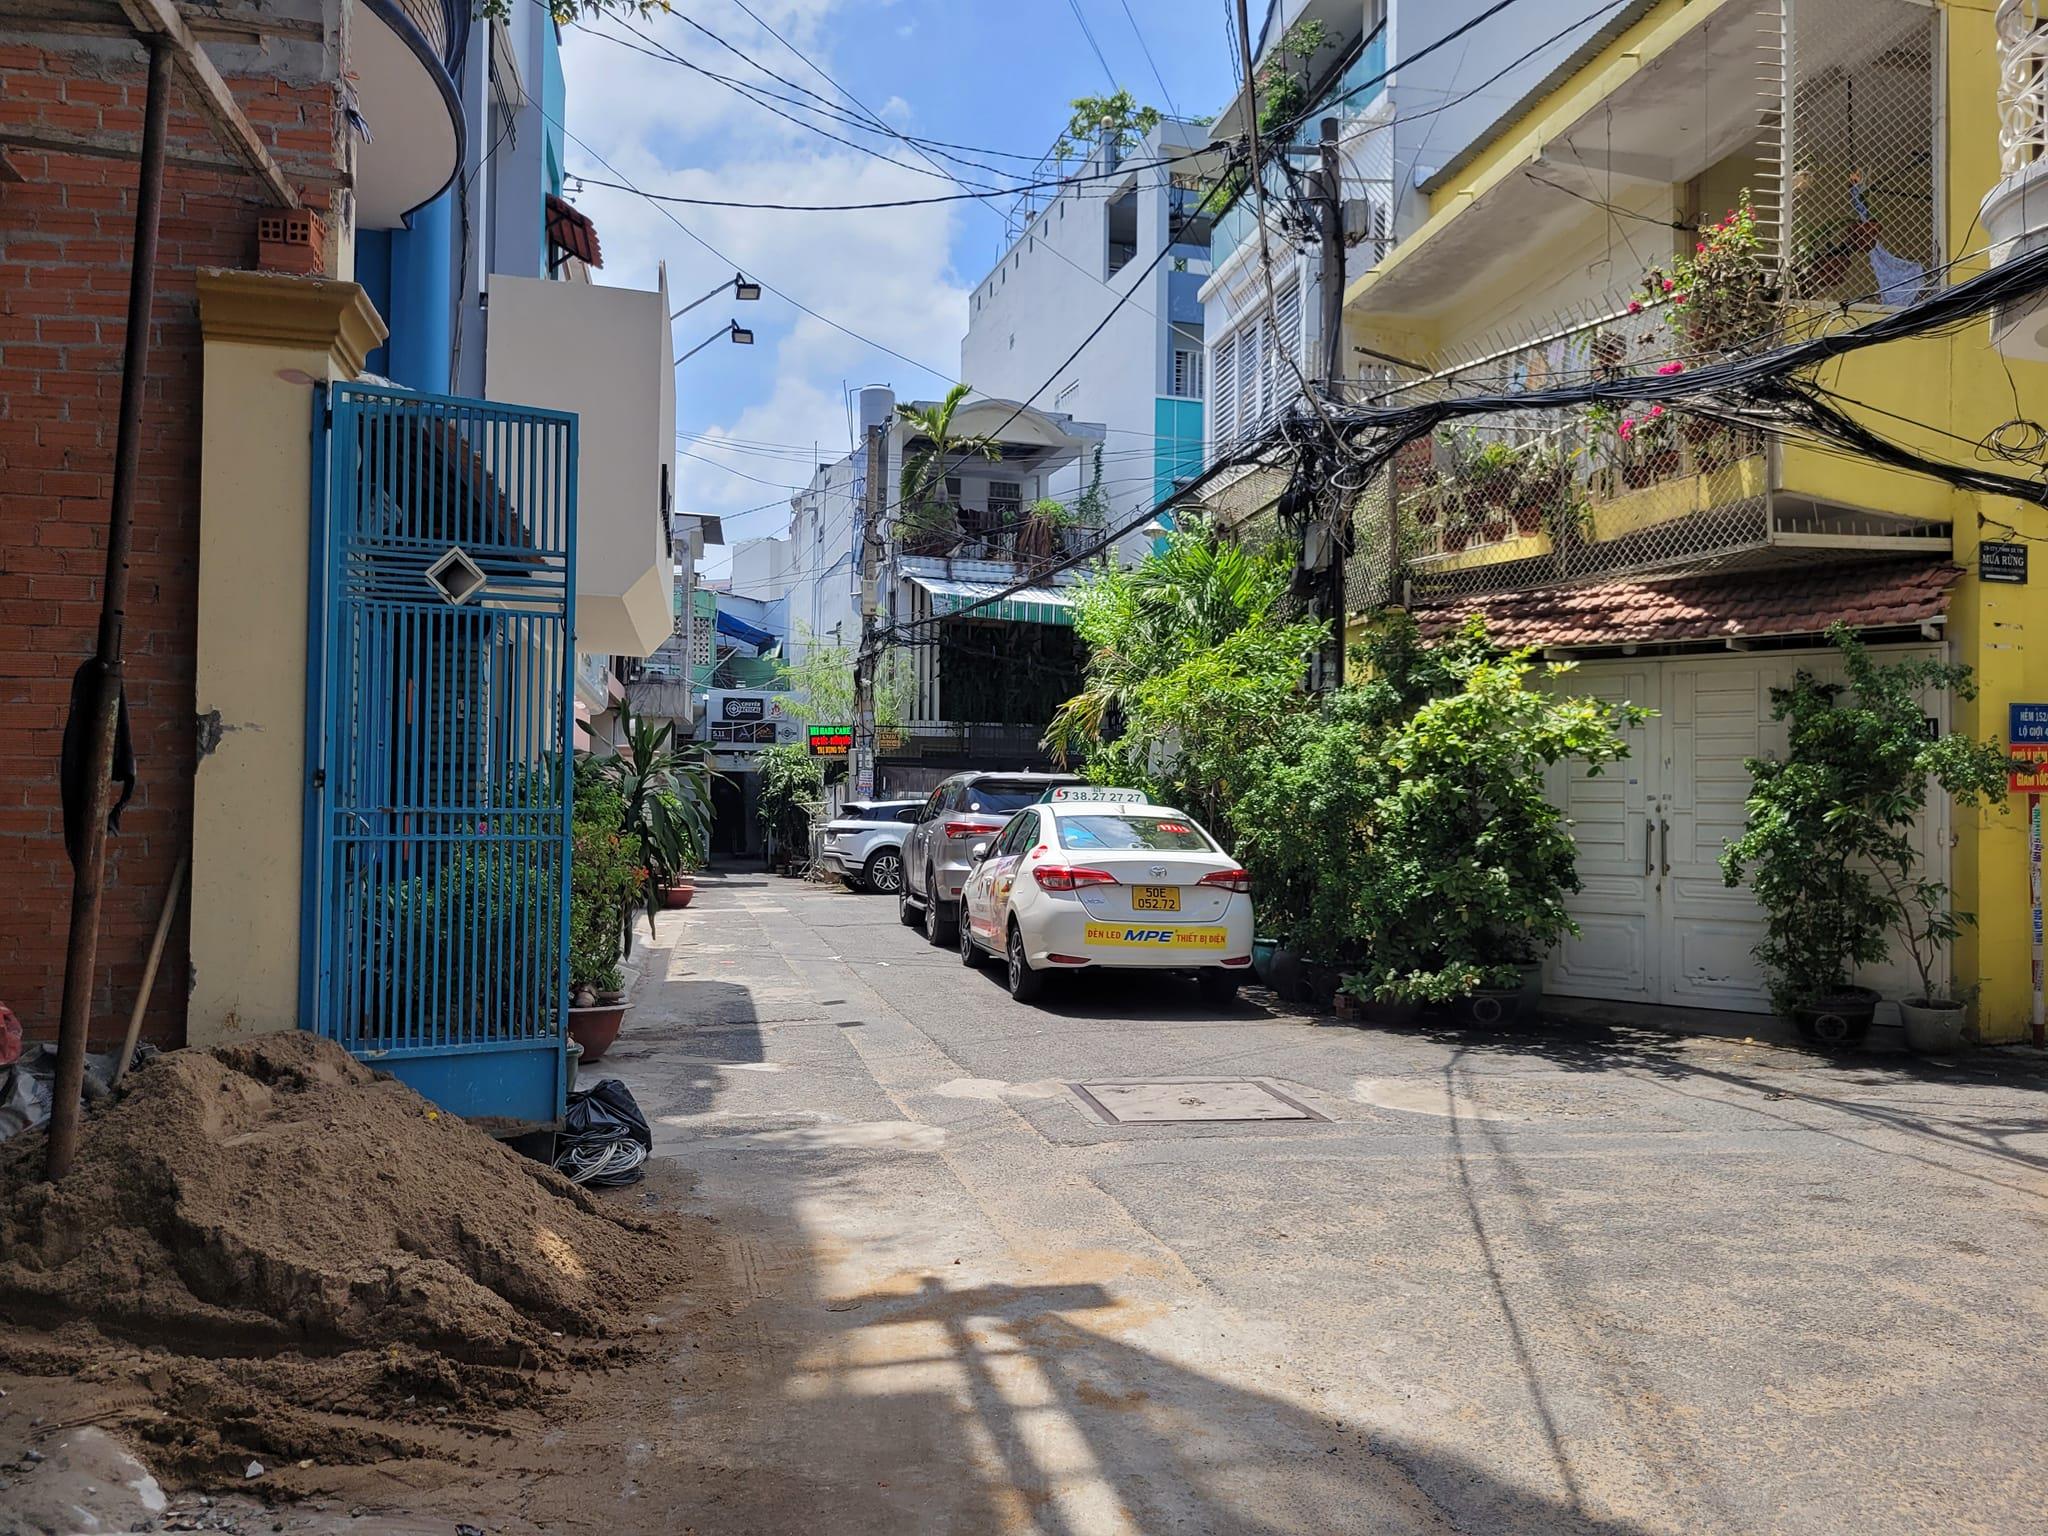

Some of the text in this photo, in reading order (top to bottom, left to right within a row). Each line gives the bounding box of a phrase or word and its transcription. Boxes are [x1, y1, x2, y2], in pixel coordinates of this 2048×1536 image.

[1072, 791, 1141, 803] 38.27 27 27
[1146, 887, 1167, 898] 50E
[1138, 898, 1175, 909] 052.72
[1106, 931, 1121, 939] LED
[1124, 929, 1174, 942] MPE
